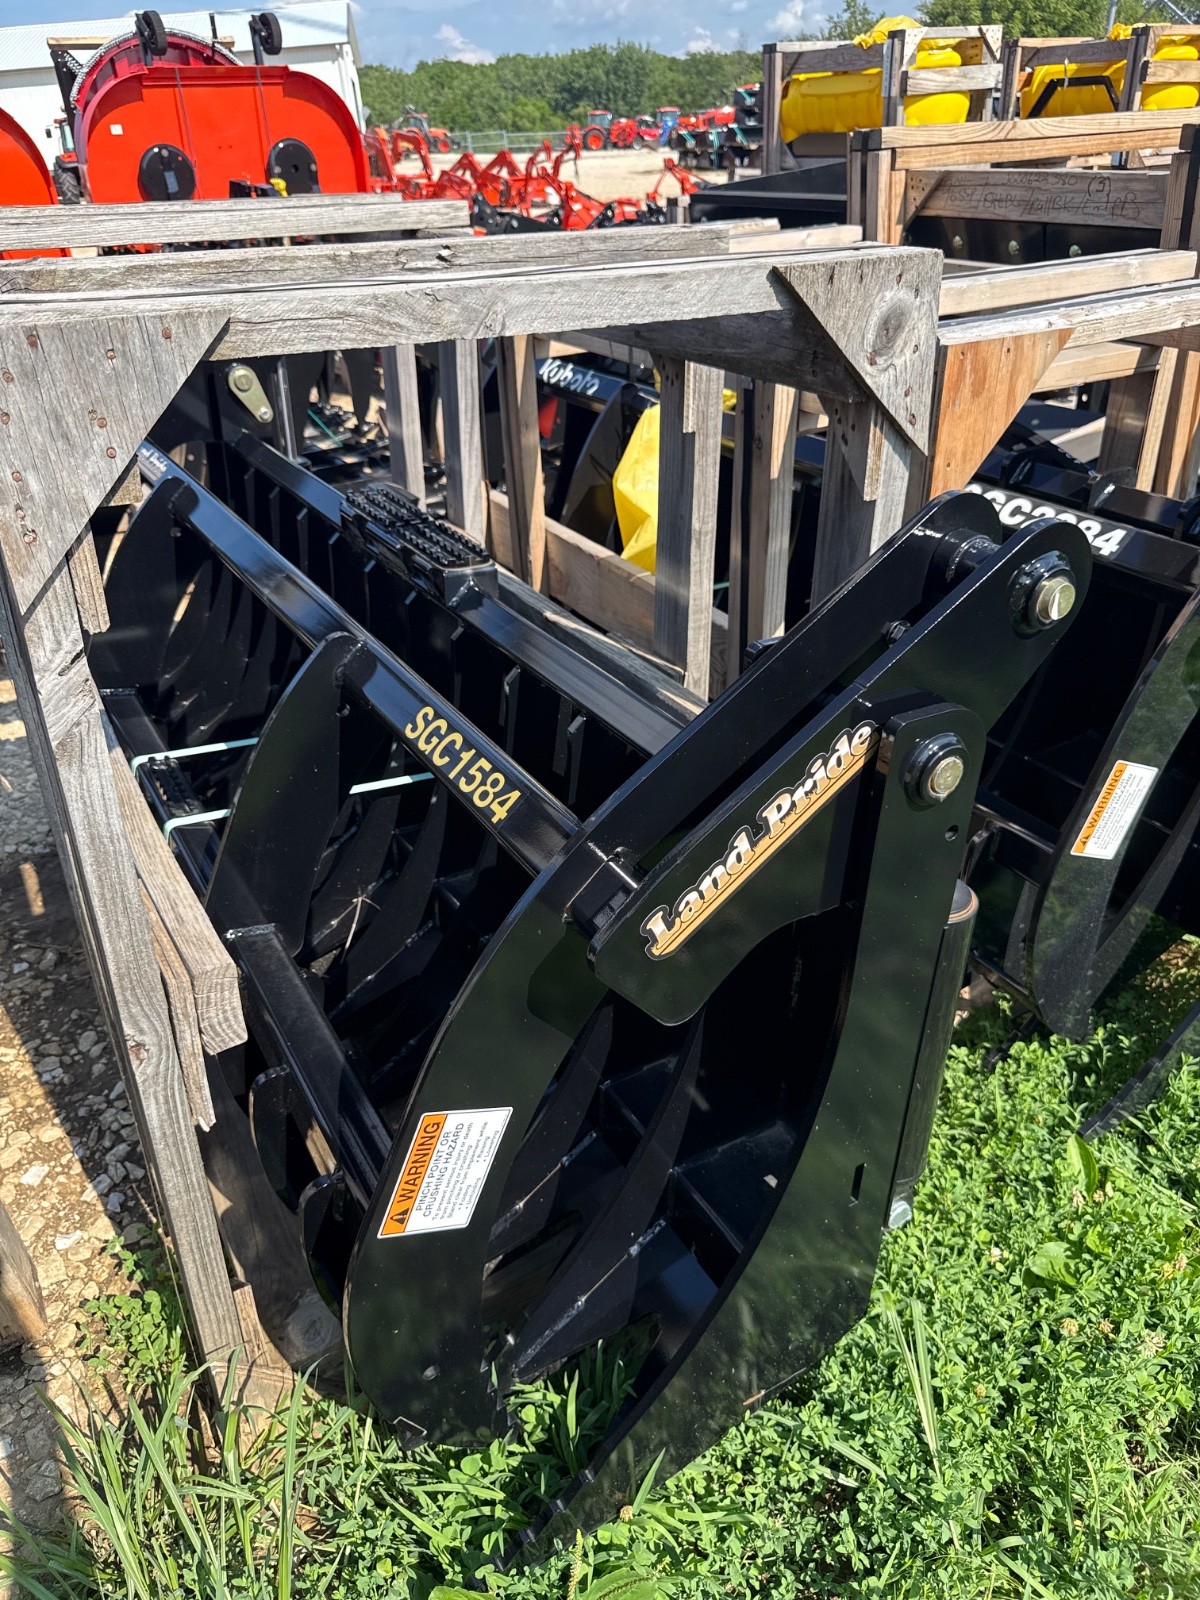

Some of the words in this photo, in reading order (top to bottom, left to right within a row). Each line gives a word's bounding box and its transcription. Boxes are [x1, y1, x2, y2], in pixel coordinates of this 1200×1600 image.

[538, 357, 600, 396] Kubota
[405, 706, 521, 824] SGC1584
[1085, 767, 1123, 829] WARNING
[645, 831, 755, 950] Land
[761, 725, 873, 839] Pride
[396, 1121, 441, 1203] WARNING
[414, 1181, 433, 1211] PINCH
[426, 1148, 445, 1178] POINT
[439, 1130, 452, 1146] OR
[421, 1165, 448, 1217] CRUSHING
[441, 1122, 465, 1164] HAZARD
[462, 1121, 474, 1140] death
